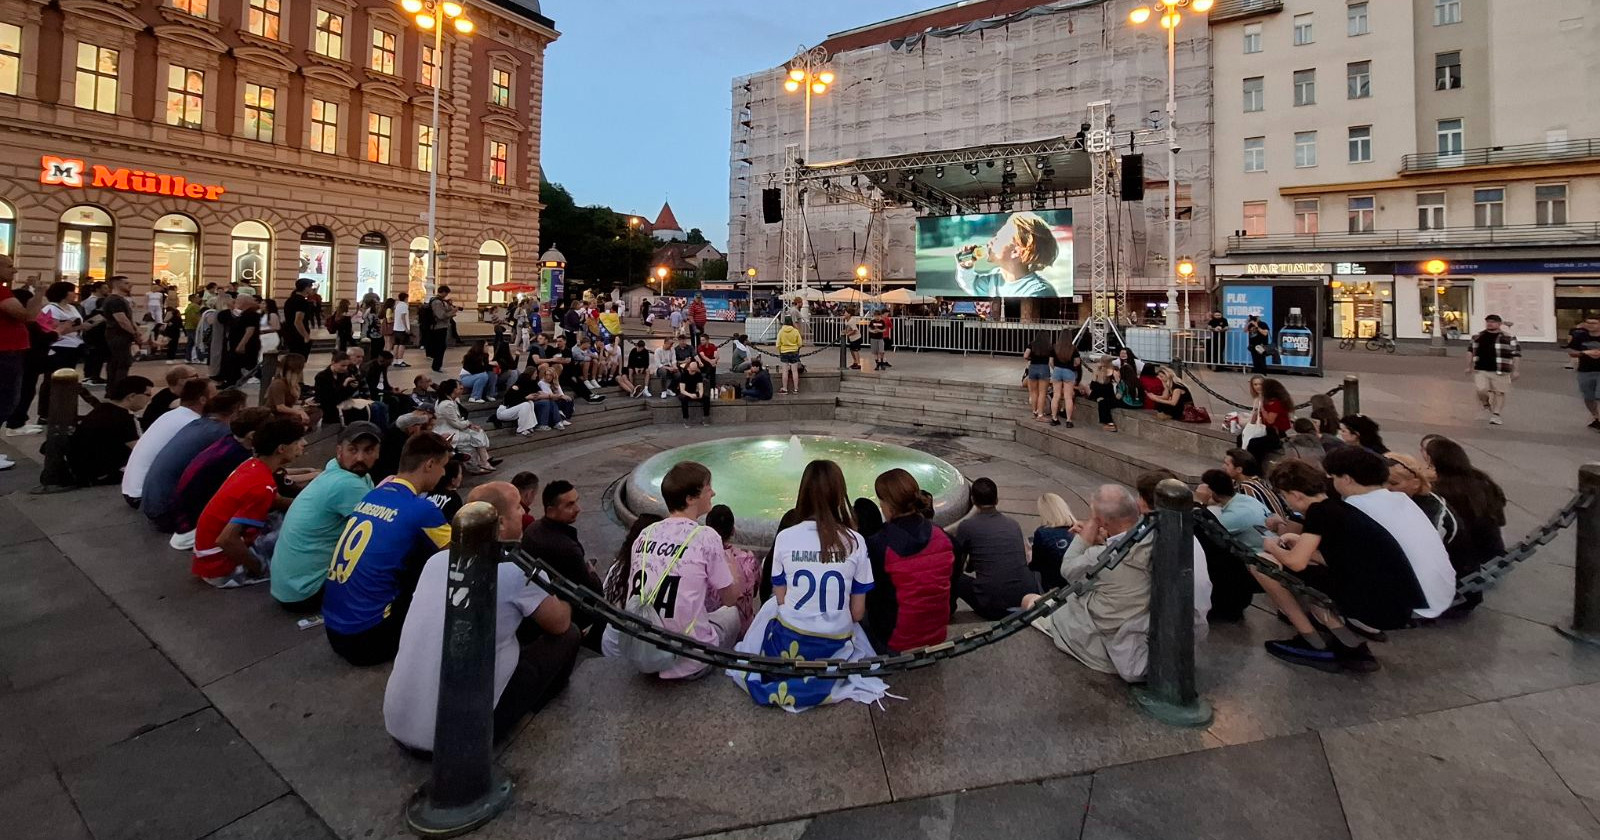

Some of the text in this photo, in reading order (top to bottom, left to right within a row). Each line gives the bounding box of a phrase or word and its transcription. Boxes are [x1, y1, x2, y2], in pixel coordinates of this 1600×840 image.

[92, 165, 225, 200] Müller
[242, 261, 262, 280] ck
[1247, 263, 1325, 274] MARTIMEX
[328, 516, 373, 584] 19
[793, 569, 846, 612] 20
